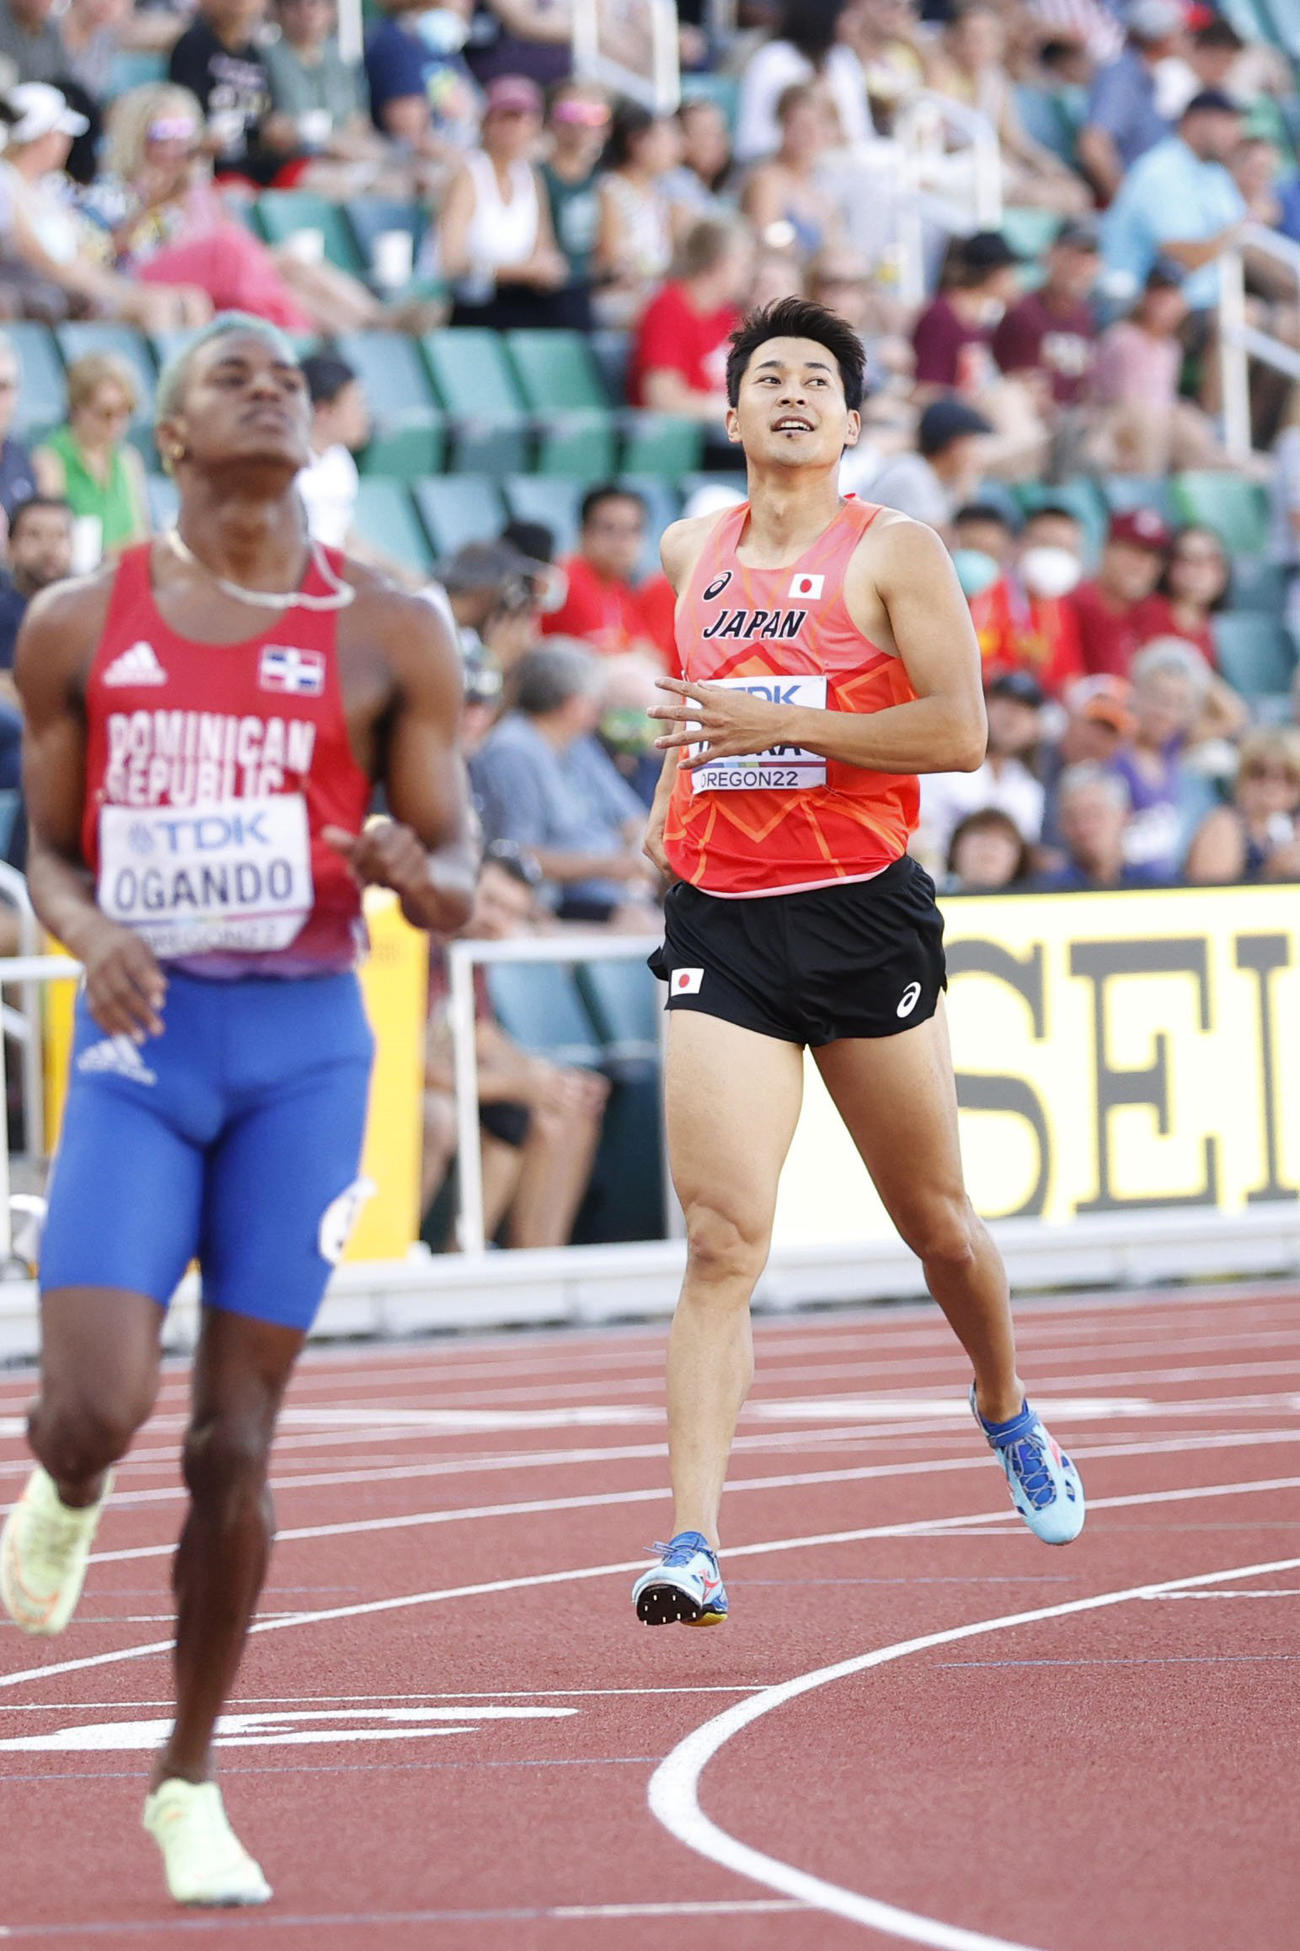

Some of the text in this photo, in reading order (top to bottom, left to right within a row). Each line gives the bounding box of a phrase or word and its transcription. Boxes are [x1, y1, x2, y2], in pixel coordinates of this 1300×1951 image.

[702, 609, 808, 640] JAPAN
[728, 685, 802, 705] DK
[107, 710, 316, 773] DOMINICAN
[105, 757, 286, 806] REPUBLIC
[156, 813, 268, 852] TDK
[113, 859, 293, 911] OGANDO
